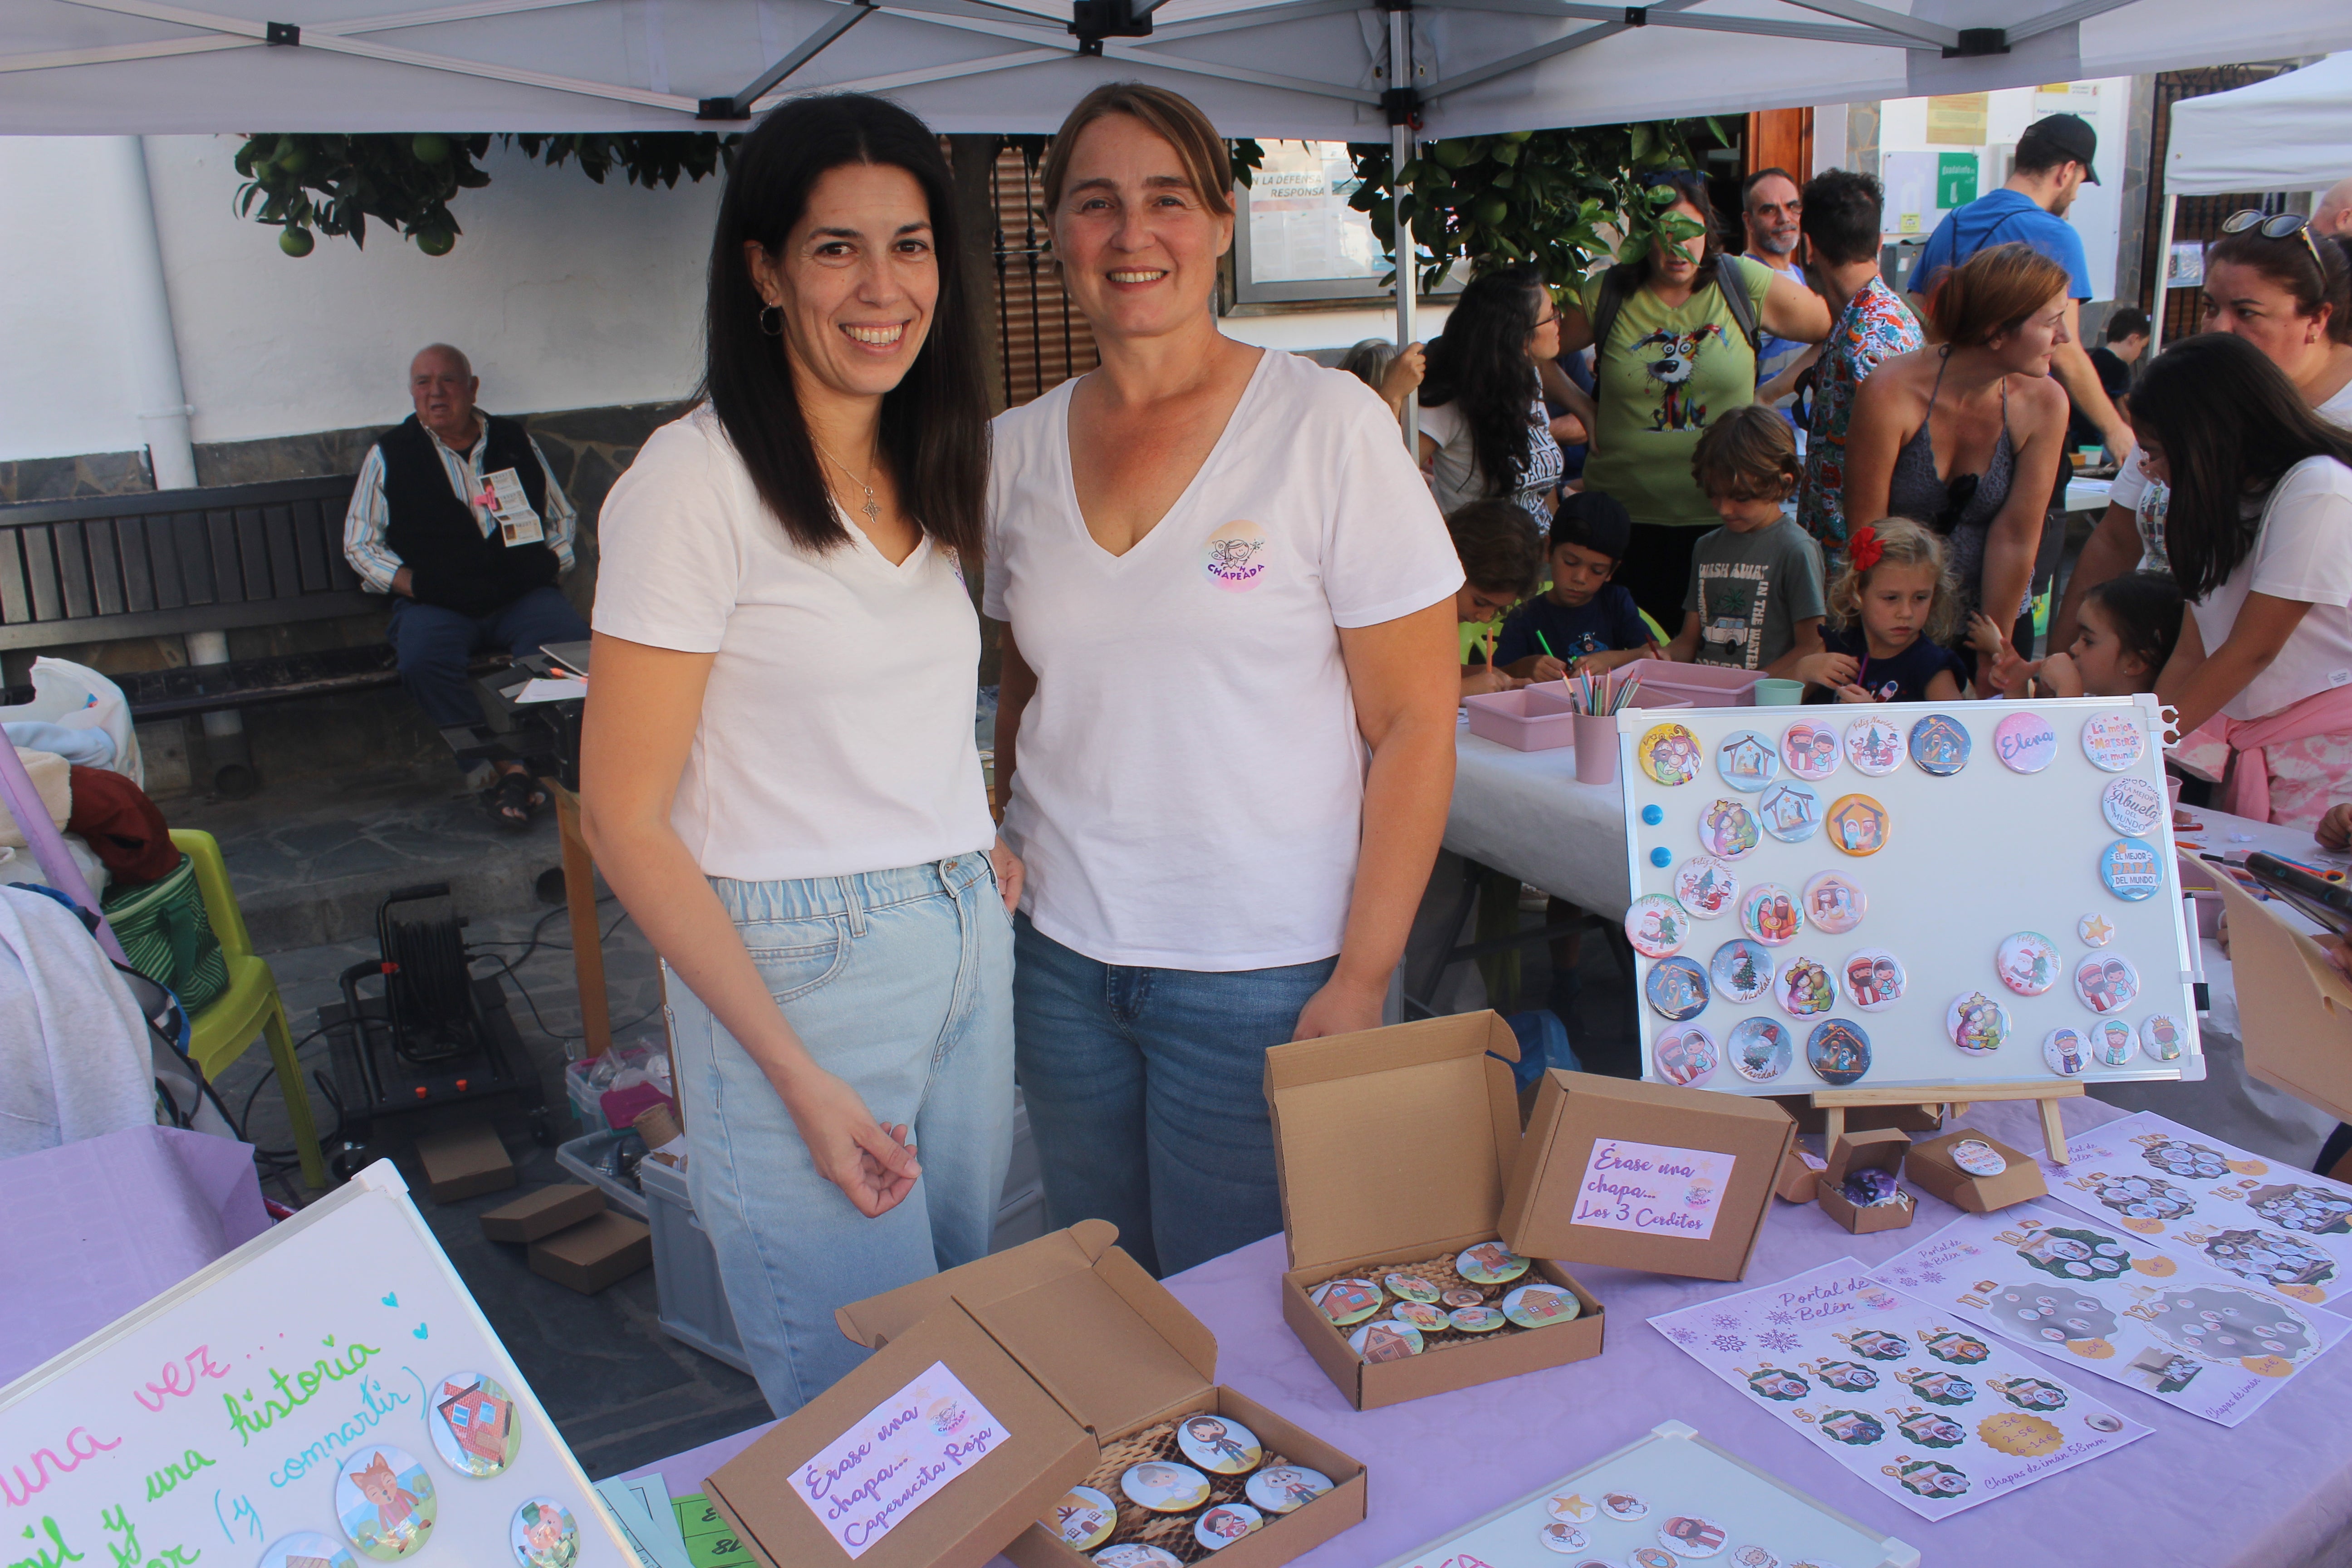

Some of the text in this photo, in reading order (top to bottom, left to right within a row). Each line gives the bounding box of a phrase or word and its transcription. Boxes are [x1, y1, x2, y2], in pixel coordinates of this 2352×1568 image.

[1263, 176, 1273, 185] LA
[1276, 174, 1322, 185] DEFENSA
[1745, 581, 1769, 670] IN THE WATER
[1852, 719, 1869, 731] Feliz
[2001, 731, 2053, 760] Elena
[2110, 749, 2139, 761] mundo
[2133, 789, 2154, 802] MEJOR
[2110, 789, 2158, 820] Abuela
[2125, 809, 2136, 818] DEL
[2112, 812, 2145, 831] MUNDO
[2124, 852, 2146, 860] MEJOR
[1691, 857, 1737, 882] Feliz Navidad
[2116, 876, 2153, 884] DEL MUNDO
[1641, 896, 1688, 926] Feliz Navidad
[2016, 934, 2060, 970] Feliz Navidad
[1739, 973, 1771, 1001] Navidad
[1739, 1065, 1778, 1079] Navidad
[2128, 1134, 2161, 1149] 13
[1594, 1143, 1695, 1178] Érase una
[2063, 1177, 2099, 1191] 14
[2209, 1186, 2244, 1201] 15
[1577, 1200, 1704, 1230] Los 3 Cerditos
[2134, 1220, 2156, 1231] 10€
[1993, 1230, 2027, 1246] 10
[2171, 1231, 2210, 1247] 16
[1918, 1242, 1950, 1259] Portal
[1950, 1239, 1961, 1248] de
[1931, 1251, 1960, 1266] Belén
[2149, 1261, 2164, 1272] 6€
[1779, 1277, 1870, 1307] Portal de
[1956, 1294, 1990, 1309] 11
[1795, 1301, 1855, 1321] Belén
[2122, 1304, 2160, 1322] 12
[1832, 1333, 1851, 1344] 3
[1916, 1330, 1937, 1343] 4
[2083, 1342, 2103, 1355] 10€
[1798, 1362, 1821, 1375] 2
[2259, 1358, 2279, 1373] 14€
[1894, 1371, 1914, 1384] 6
[1985, 1379, 2009, 1393] 8
[2205, 1399, 2236, 1420] Chapas
[2233, 1390, 2244, 1401] de
[1792, 1408, 1815, 1423] 5
[1884, 1407, 1907, 1423] 7
[101, 1503, 142, 1565] y
[146, 1449, 216, 1502] una
[223, 1333, 381, 1447] historia
[806, 1406, 919, 1500] Érase una
[0, 1425, 122, 1507] una
[1881, 1465, 1903, 1480] 9
[1984, 1469, 2026, 1490] Chapas
[2027, 1462, 2041, 1473] de
[2038, 1451, 2069, 1468] imán
[844, 1427, 992, 1547] Caperucita Roja
